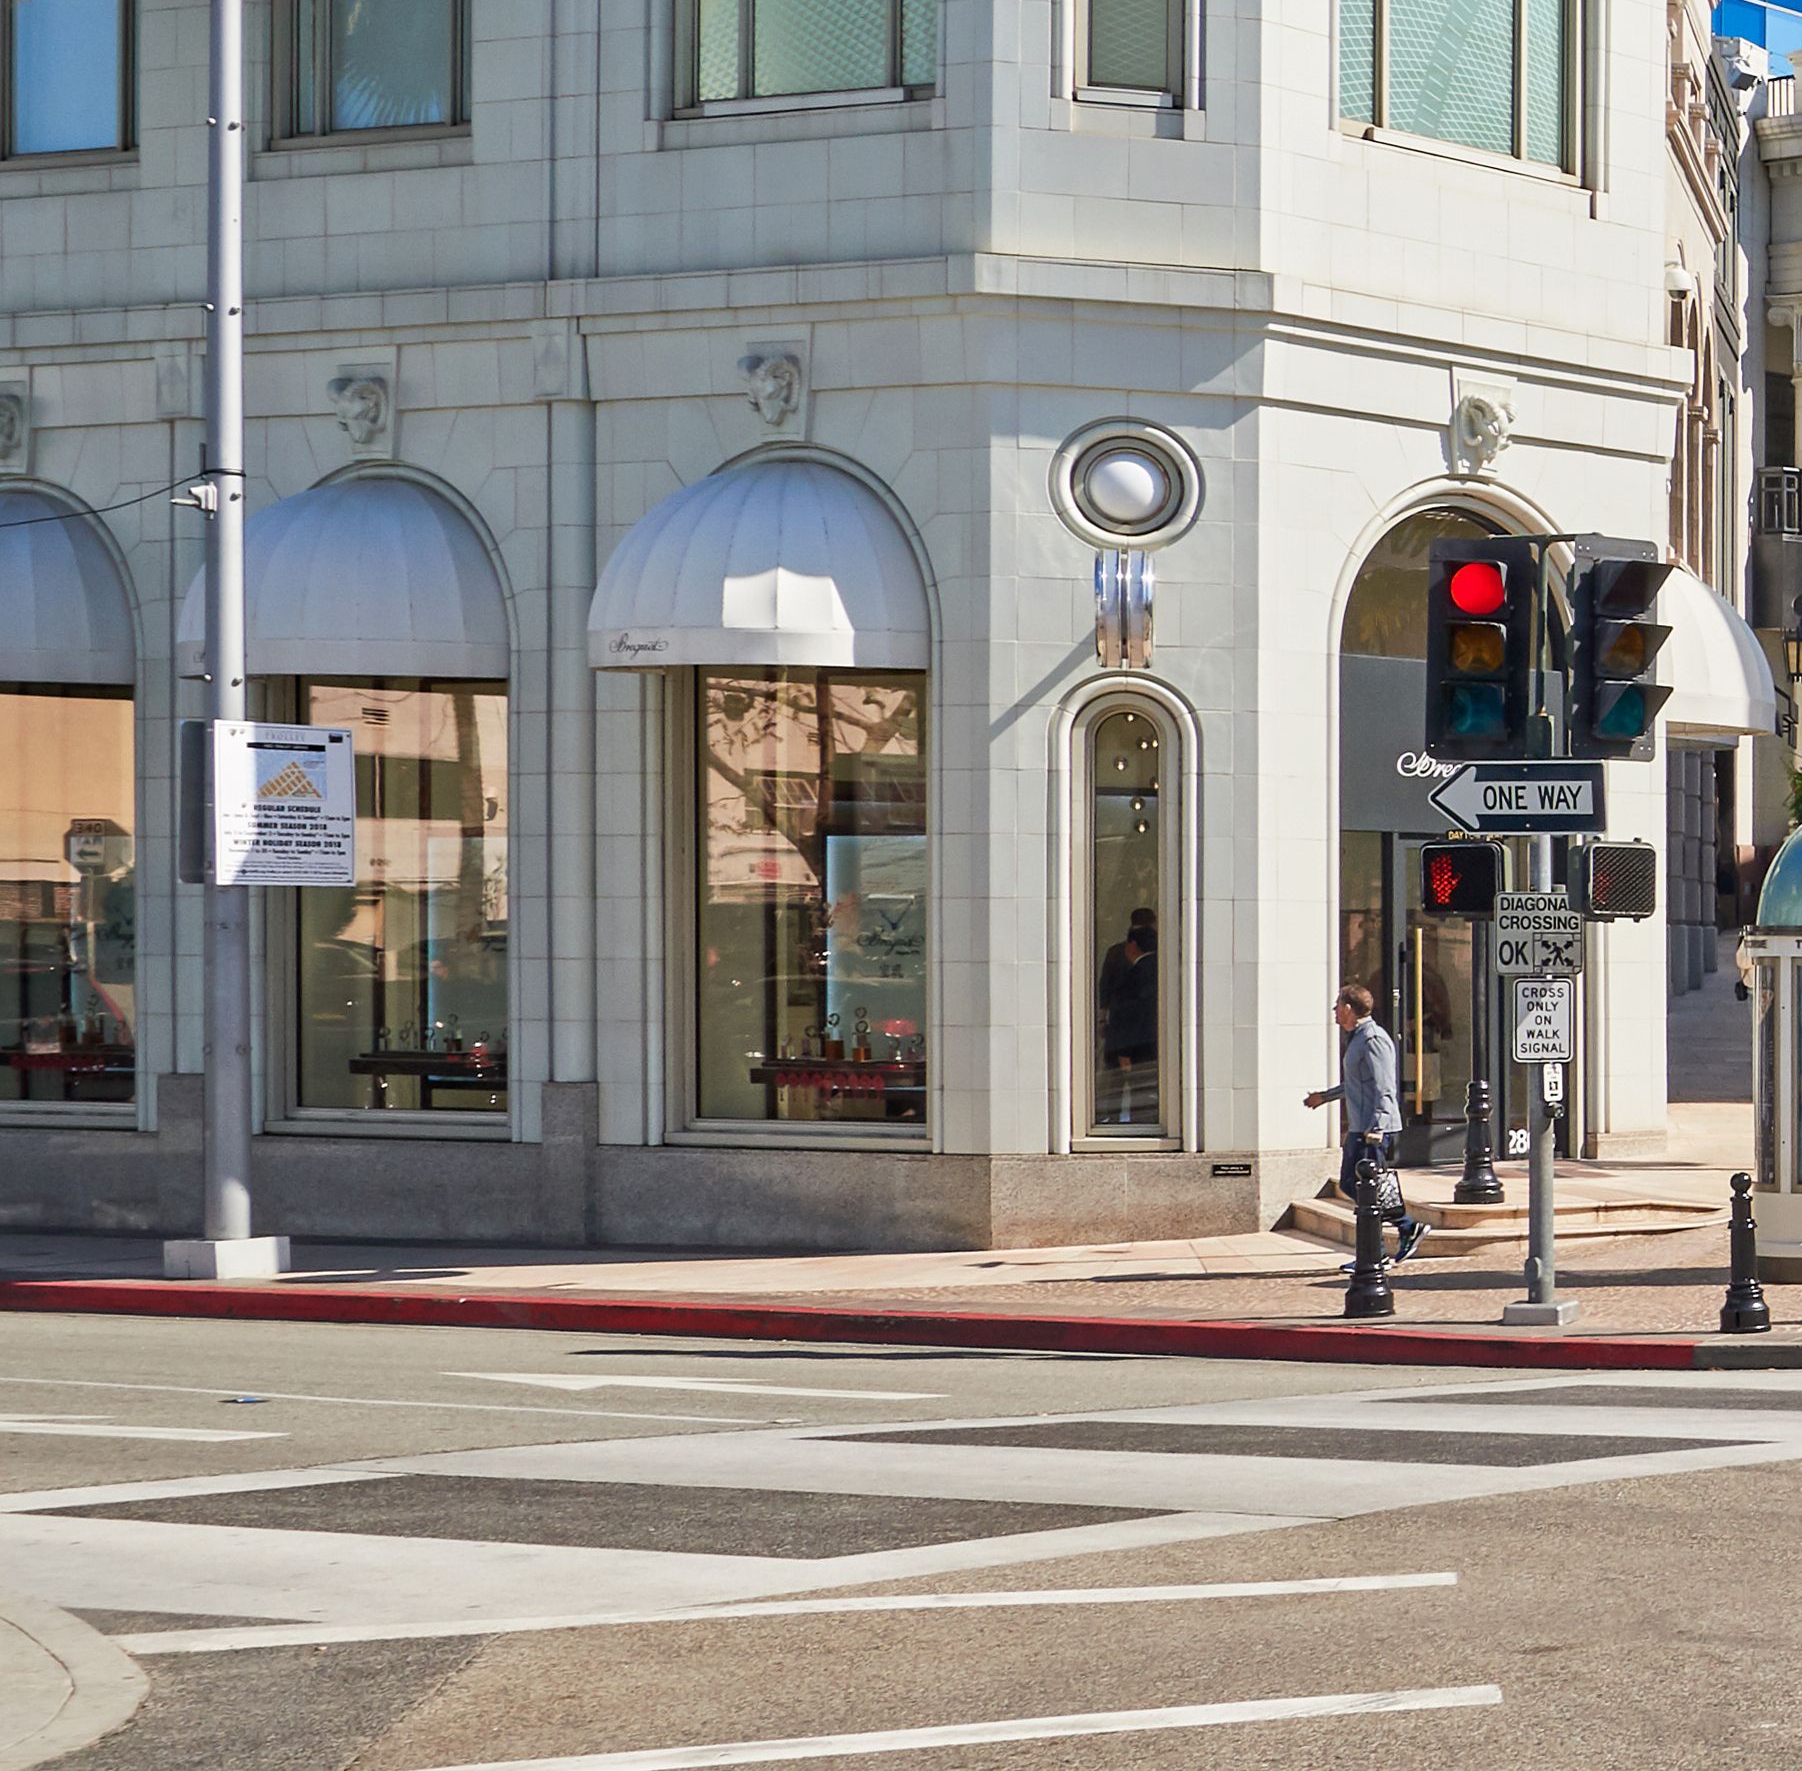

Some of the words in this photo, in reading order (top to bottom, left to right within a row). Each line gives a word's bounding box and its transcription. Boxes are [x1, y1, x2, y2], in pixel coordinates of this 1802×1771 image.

[1483, 785, 1528, 810] ONE
[1538, 785, 1582, 810] WAY
[288, 805, 321, 813] SCHEDULE
[281, 822, 306, 830] SEASON
[309, 823, 327, 831] 2018
[295, 840, 321, 848] SEASON
[1501, 897, 1568, 911] DIAGONA
[1499, 915, 1579, 930] CROSSING
[1499, 940, 1529, 966] OK
[1522, 987, 1564, 998] CROSS
[1527, 1001, 1559, 1012] ONLY
[1535, 1015, 1552, 1026] ON
[1526, 1029, 1560, 1040] WALK
[1520, 1042, 1566, 1054] SIGNAL
